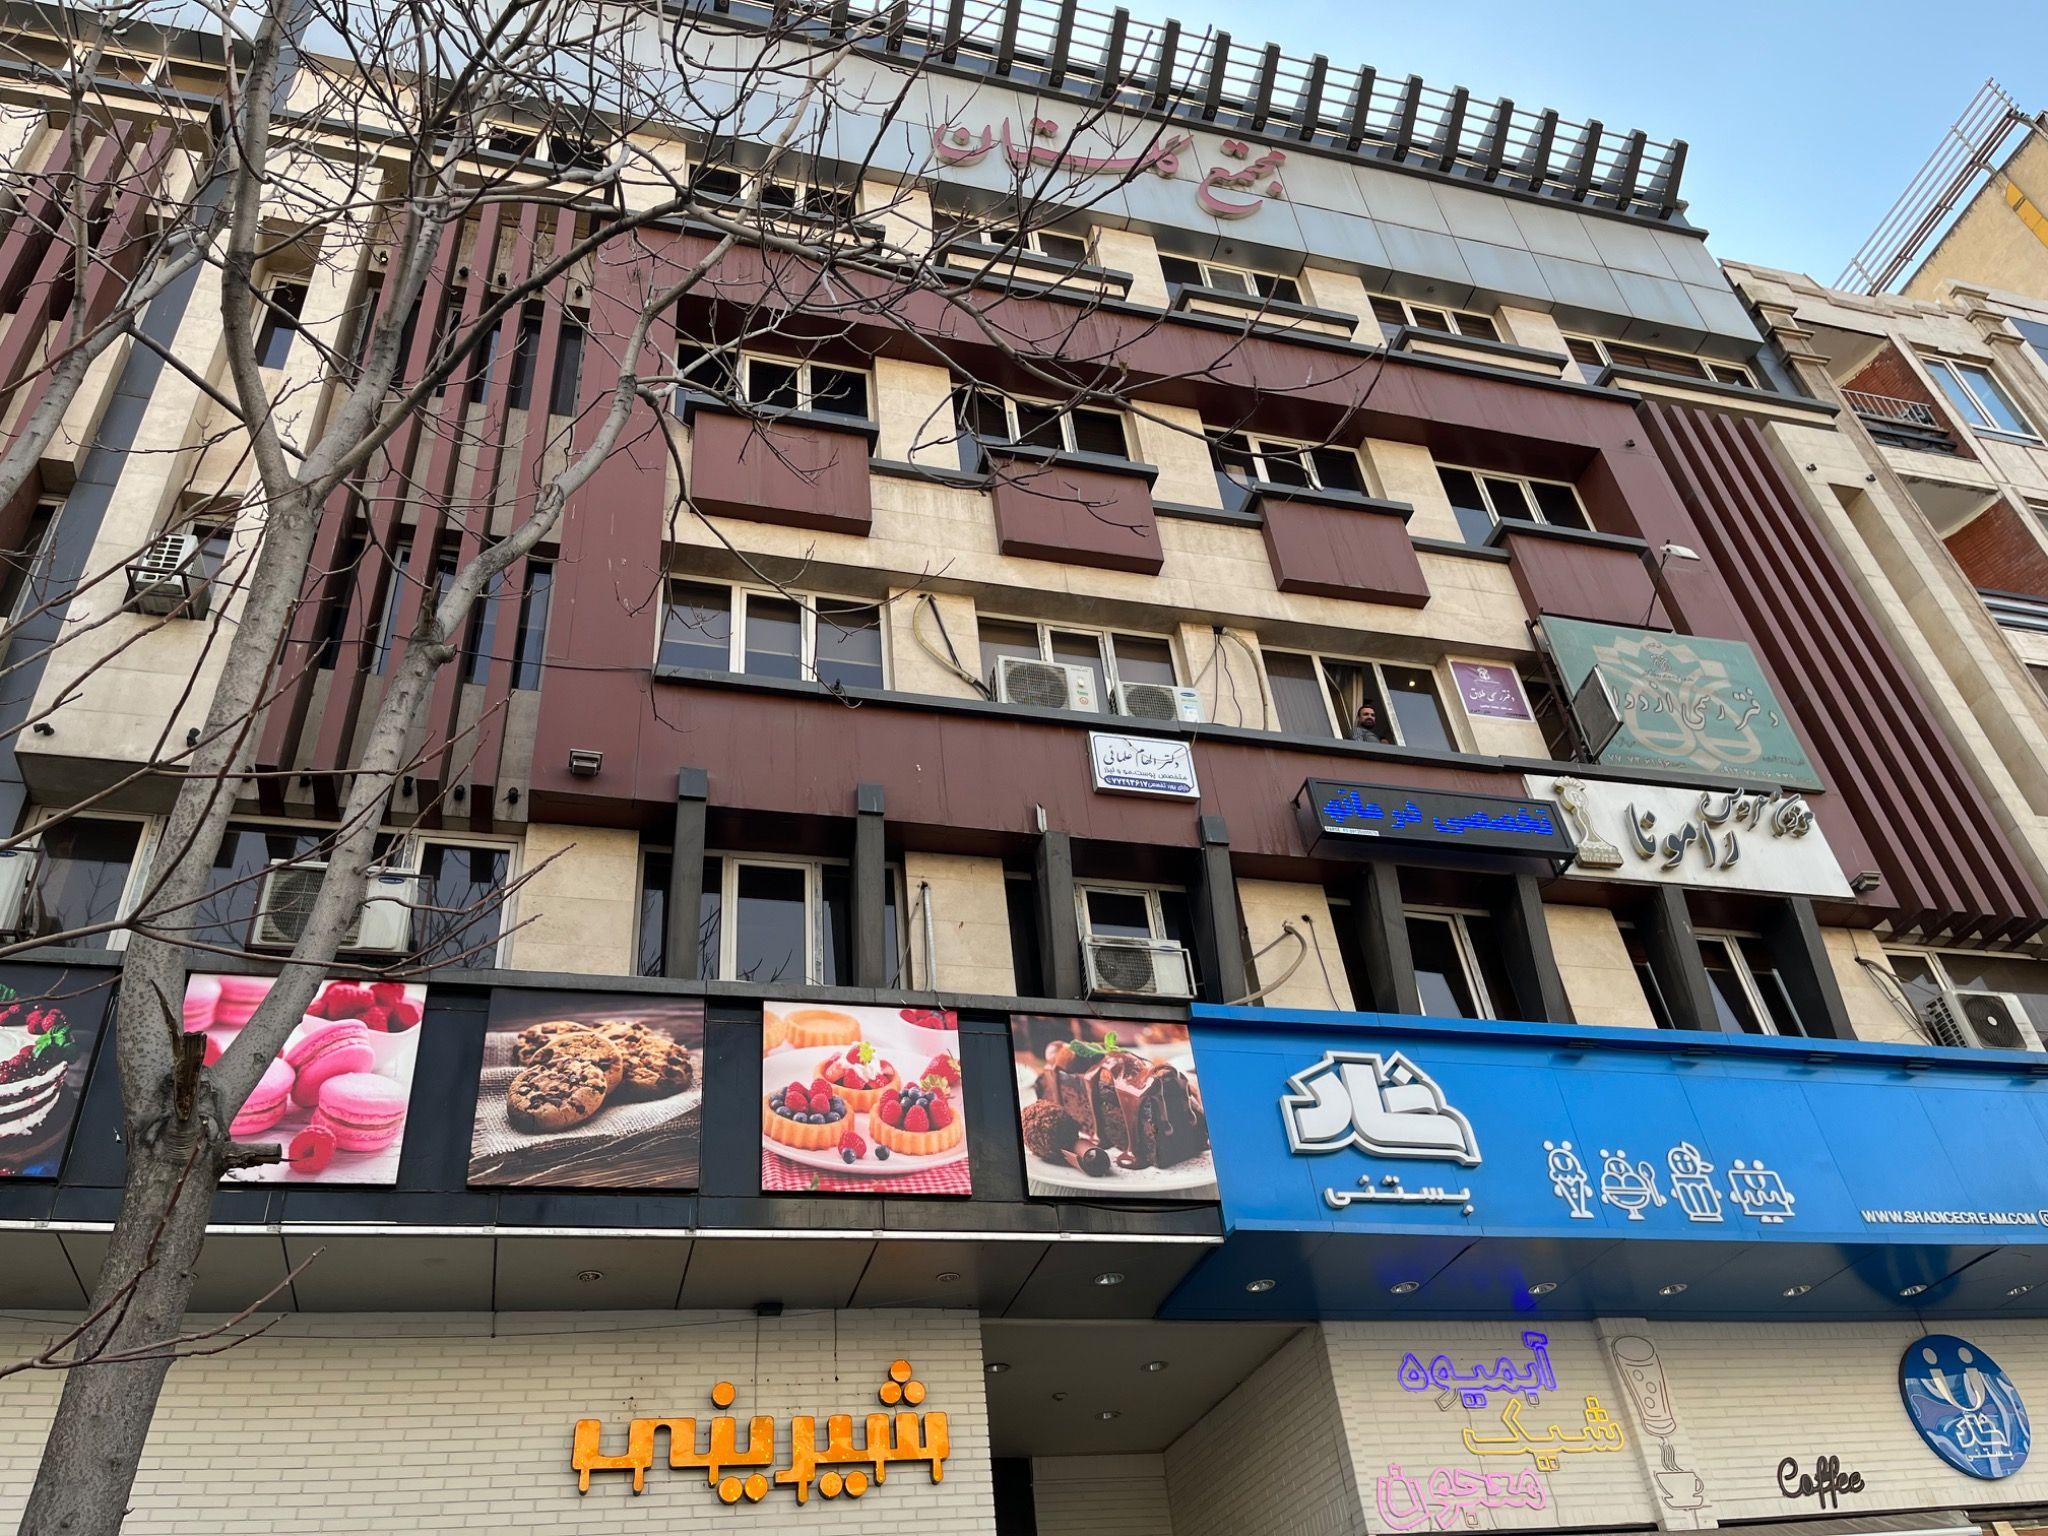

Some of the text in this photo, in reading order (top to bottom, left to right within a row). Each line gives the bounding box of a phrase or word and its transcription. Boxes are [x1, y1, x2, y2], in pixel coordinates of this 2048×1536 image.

[1611, 682, 1780, 731] دفتر رسمی ازدوا
[1136, 749, 1157, 767] الهام
[1157, 747, 1183, 770] دکتر
[1624, 802, 1740, 872] رامونا
[1324, 1174, 1474, 1216] بستنی
[1861, 1209, 2038, 1226] WWW.SHADICECREAM.COM
[571, 1359, 951, 1507] شیرینی
[1462, 1394, 1626, 1472] شیک
[1967, 1447, 2015, 1462] بستنی
[1377, 1462, 1547, 1531] معجون
[1777, 1454, 1866, 1510] Coffee
